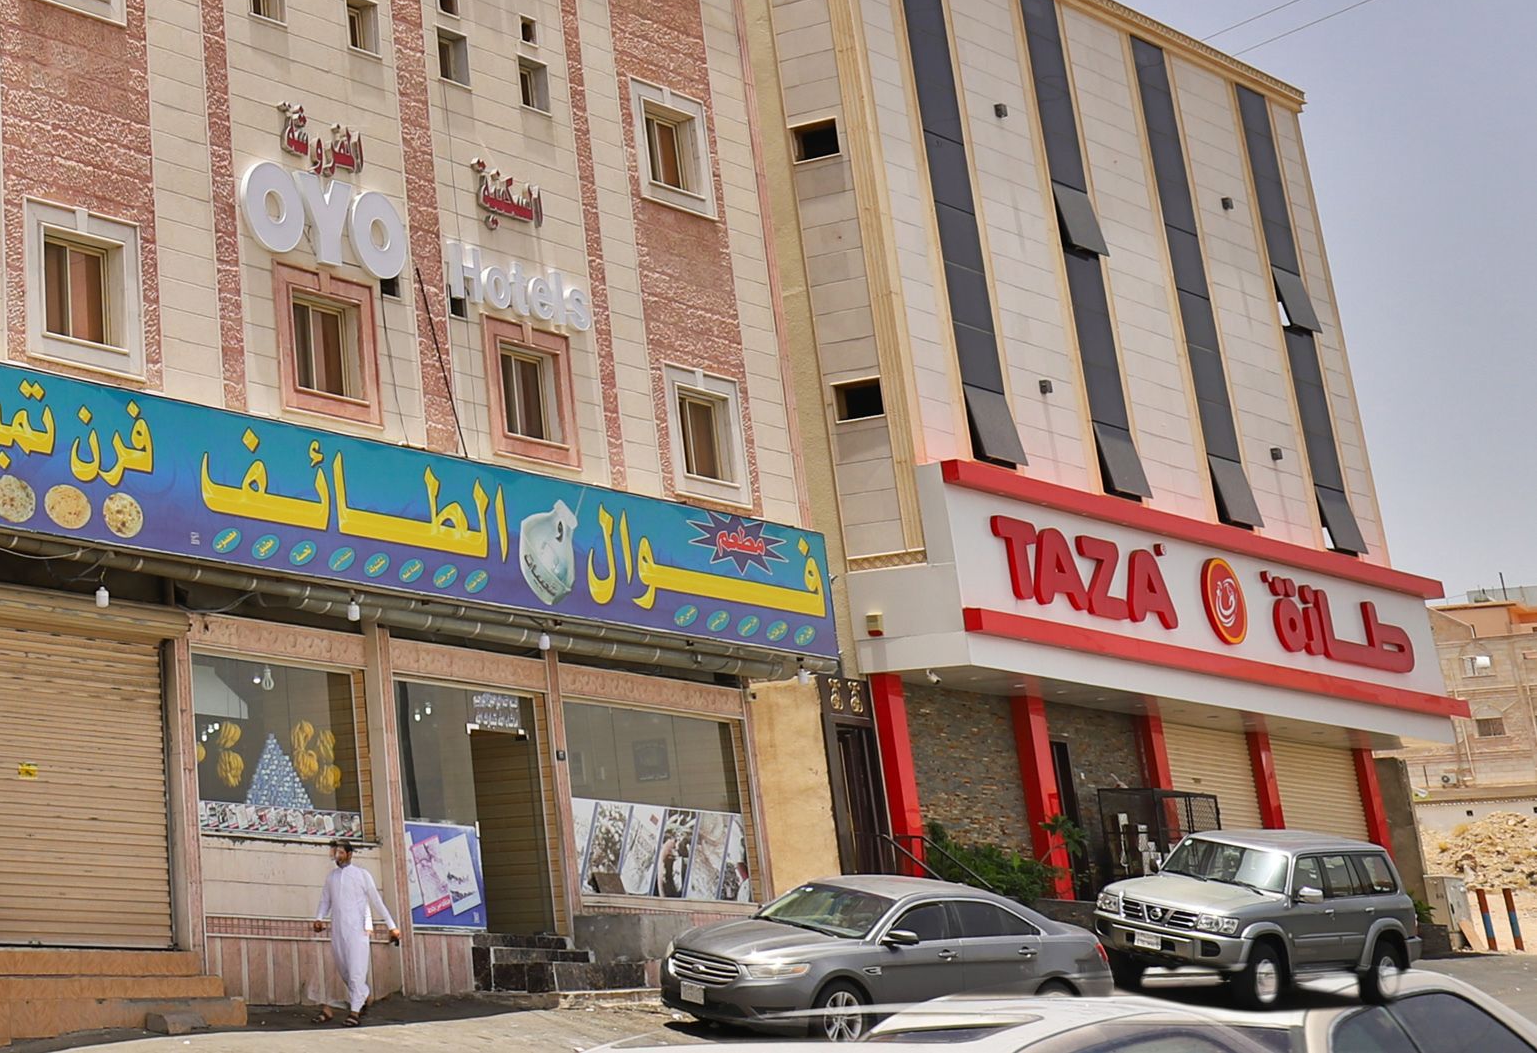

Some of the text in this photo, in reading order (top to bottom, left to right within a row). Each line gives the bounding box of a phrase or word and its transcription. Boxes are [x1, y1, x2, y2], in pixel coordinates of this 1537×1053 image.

[239, 161, 591, 332] OYO Hotels
[69, 399, 155, 487] فرن
[200, 426, 829, 619] فوال الطائف
[716, 525, 766, 557] مطعم
[989, 515, 1179, 630] TAZA
[1271, 575, 1415, 674] طازة
